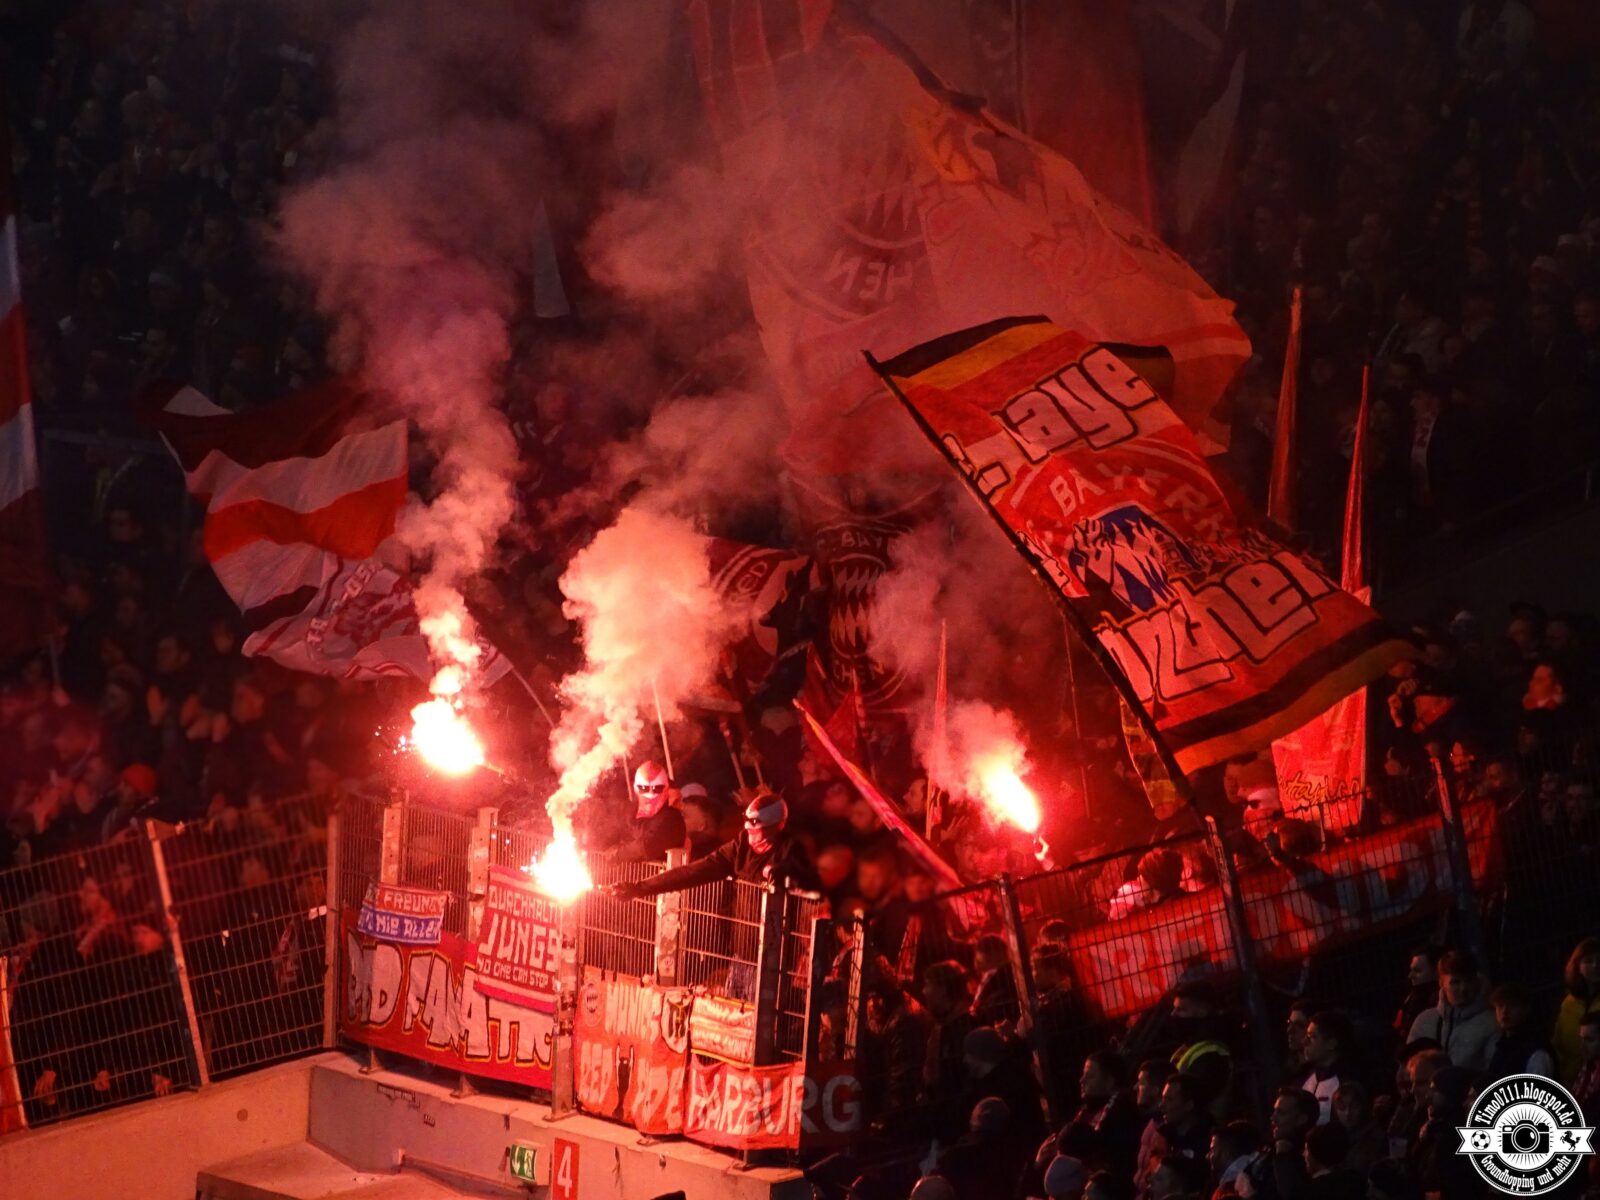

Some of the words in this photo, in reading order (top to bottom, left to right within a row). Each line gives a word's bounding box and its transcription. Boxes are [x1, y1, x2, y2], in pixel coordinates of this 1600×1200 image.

[478, 913, 562, 972] JUNGS
[477, 956, 491, 975] NO
[529, 970, 549, 989] STOP
[579, 1041, 613, 1104] RED
[557, 1145, 573, 1198] 4
